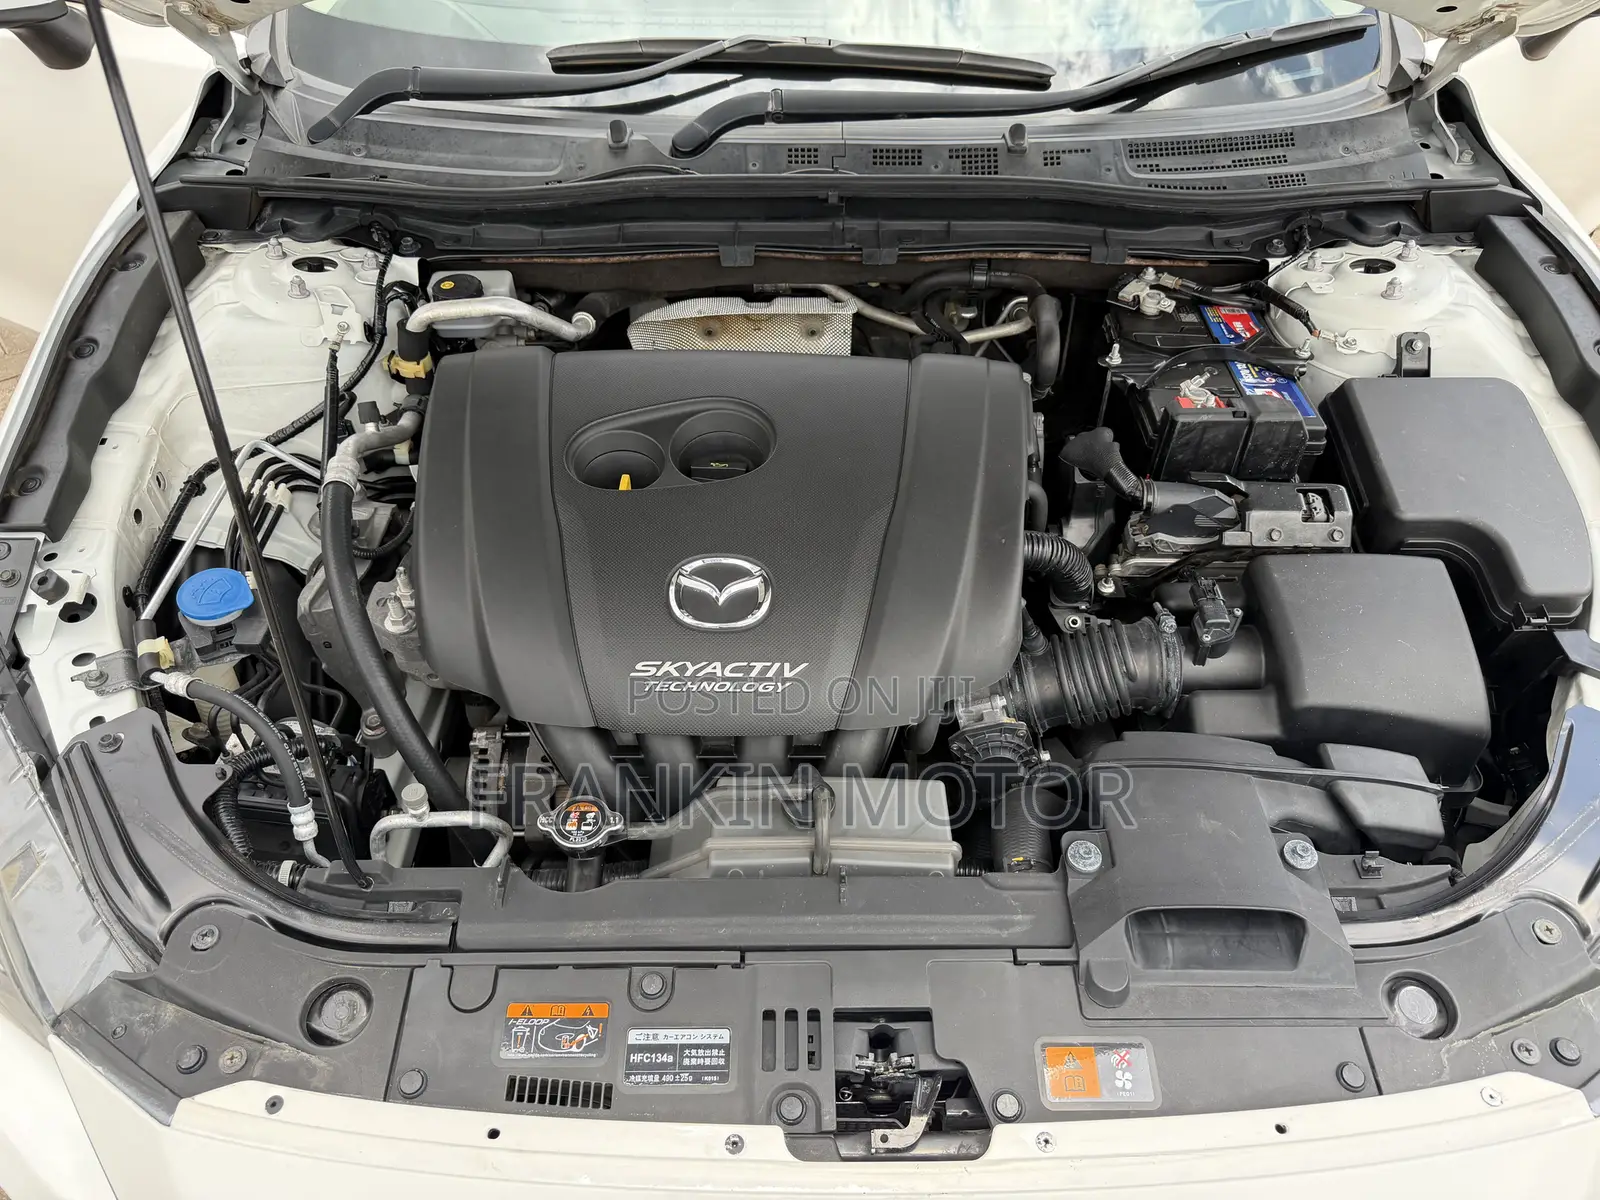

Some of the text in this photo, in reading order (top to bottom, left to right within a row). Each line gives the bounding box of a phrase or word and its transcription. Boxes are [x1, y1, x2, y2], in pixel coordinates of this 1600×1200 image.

[629, 661, 810, 678] SKYACTIV
[643, 681, 793, 693] TECHNOLOGY
[635, 1033, 660, 1041] ご注意
[663, 1033, 698, 1041] カーエアコン
[683, 1048, 726, 1057] 大気放出禁止
[629, 1053, 674, 1063] HFC134a
[662, 1074, 674, 1082] 490
